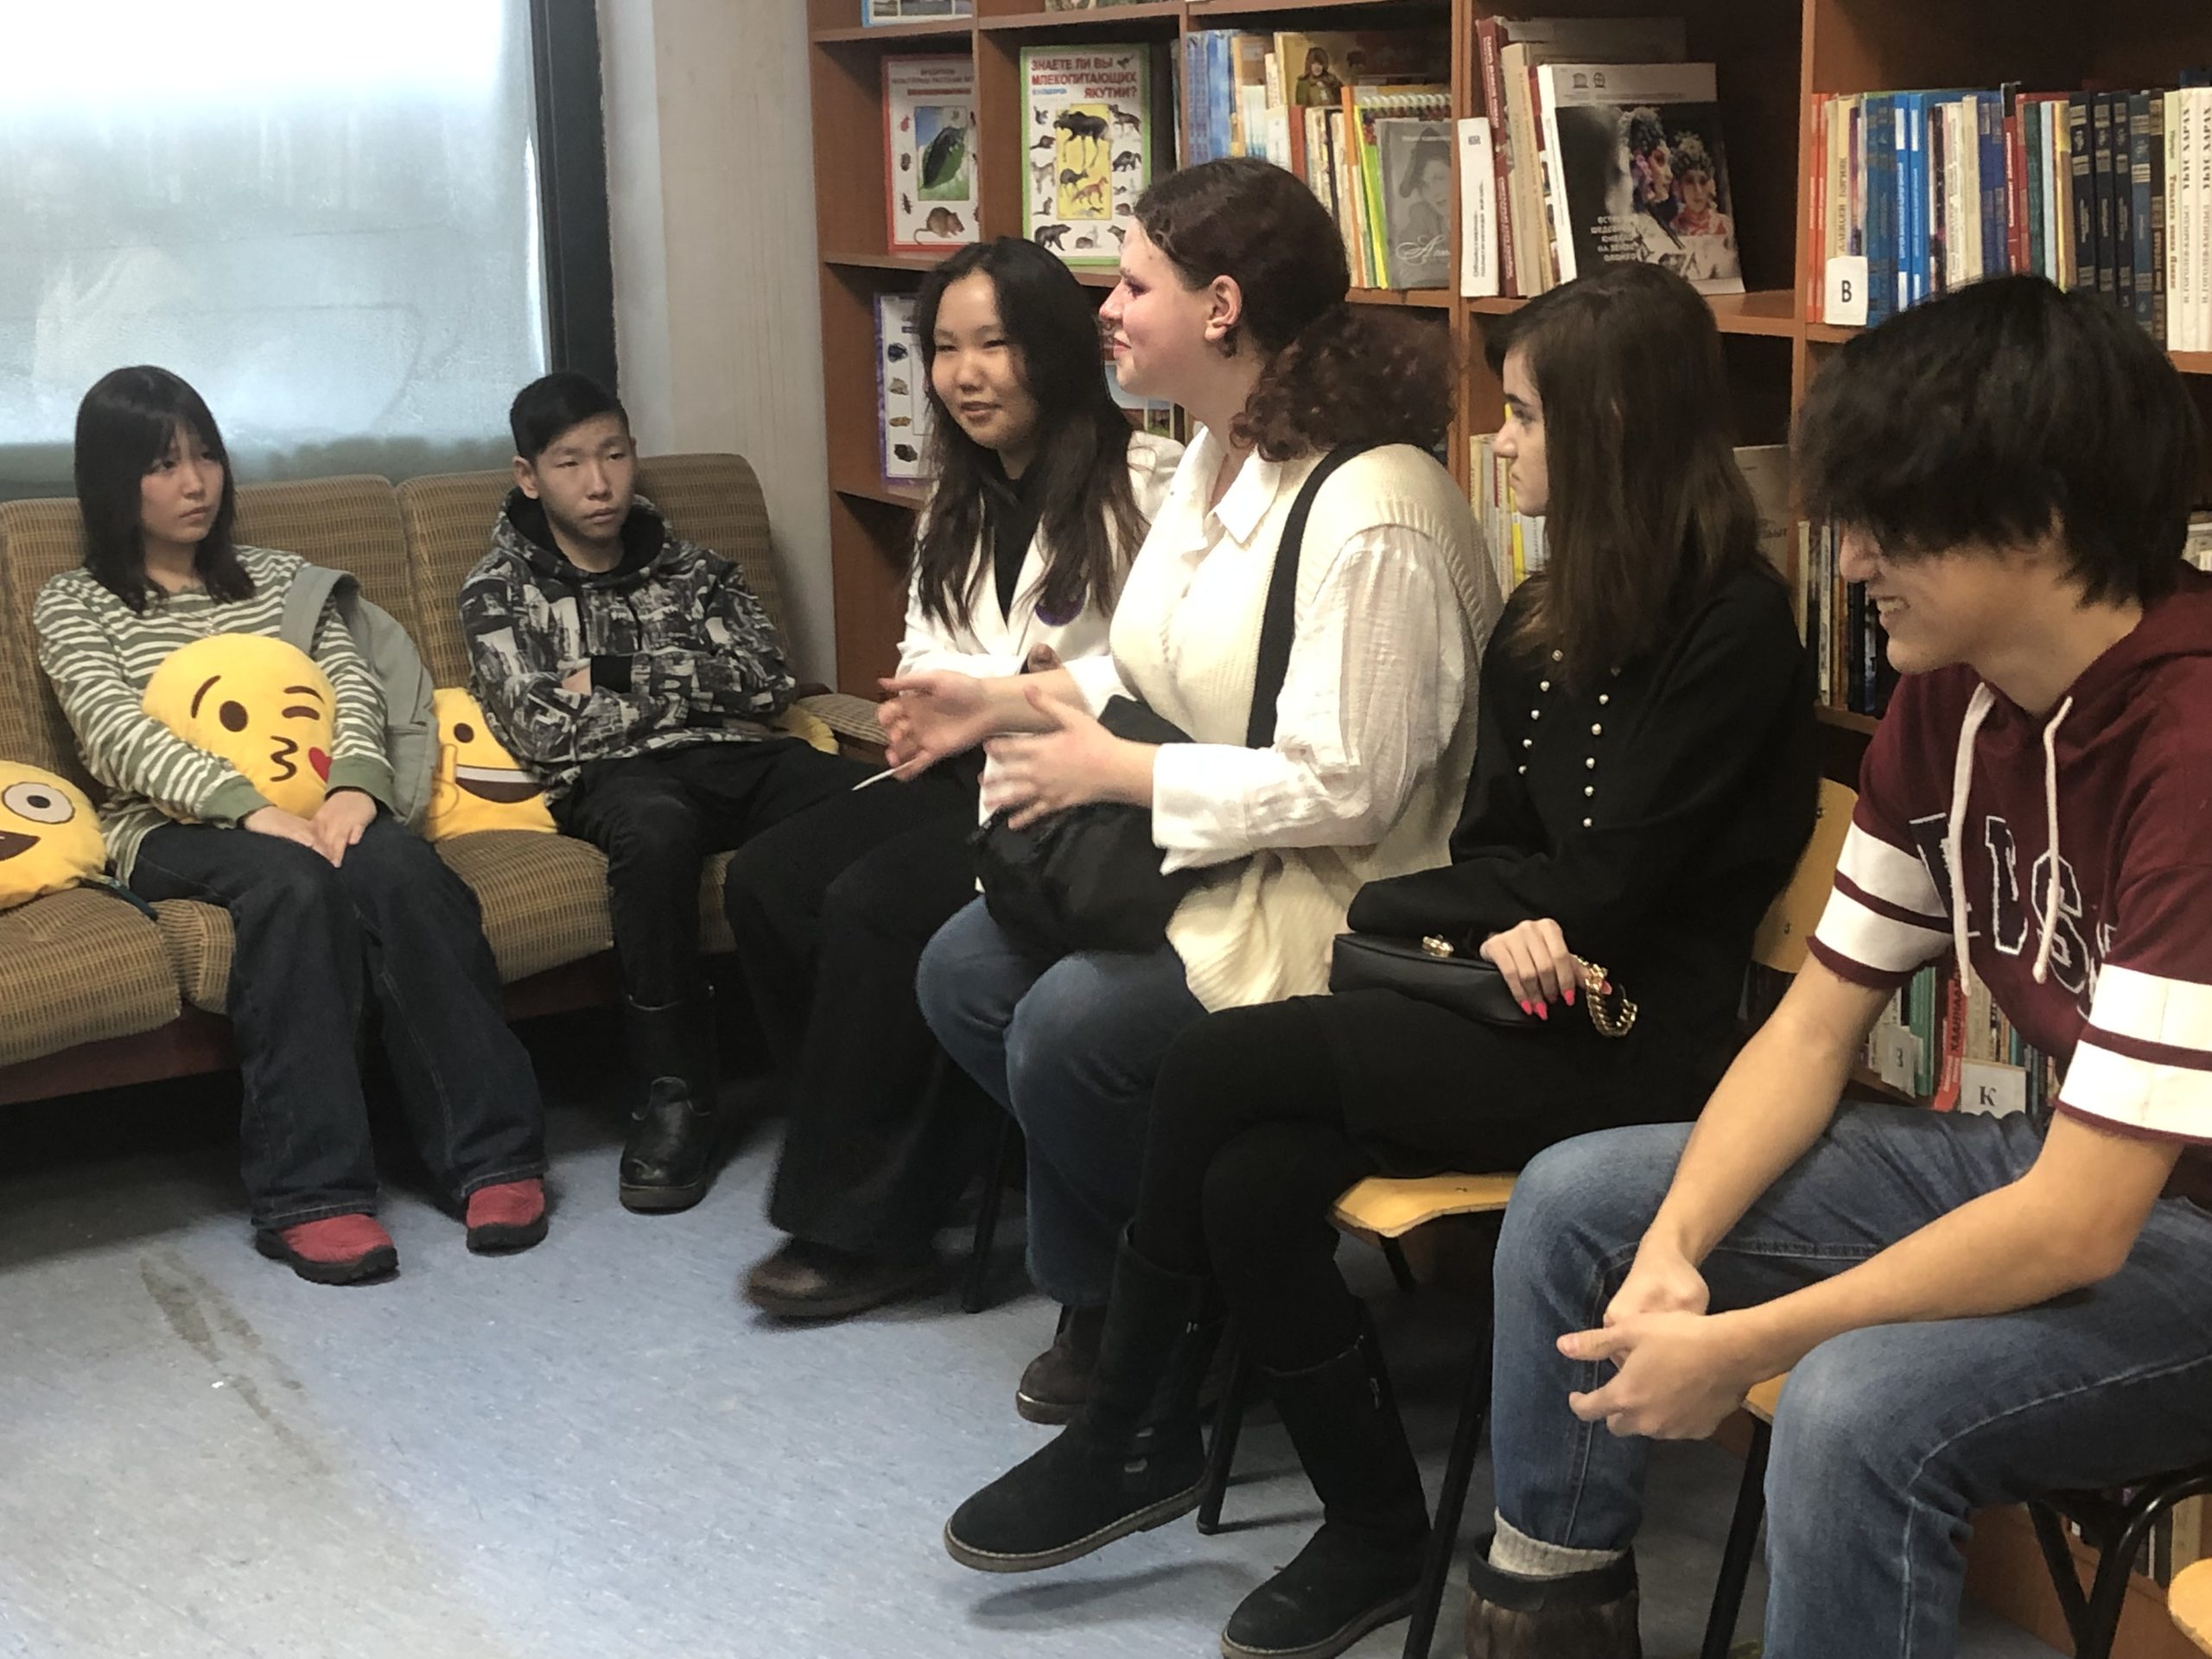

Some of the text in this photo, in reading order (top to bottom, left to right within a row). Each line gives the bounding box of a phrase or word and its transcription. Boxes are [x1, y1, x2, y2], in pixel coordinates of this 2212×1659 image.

[1032, 58, 1113, 70] ЗНАЕТЕ ЛИ ВЫ
[1032, 72, 1137, 85] МЛЕКОПИТАЮЩИХ
[1084, 86, 1137, 98] ЯКУТИИ?
[1841, 279, 1853, 303] В
[1979, 1085, 1997, 1107] К
